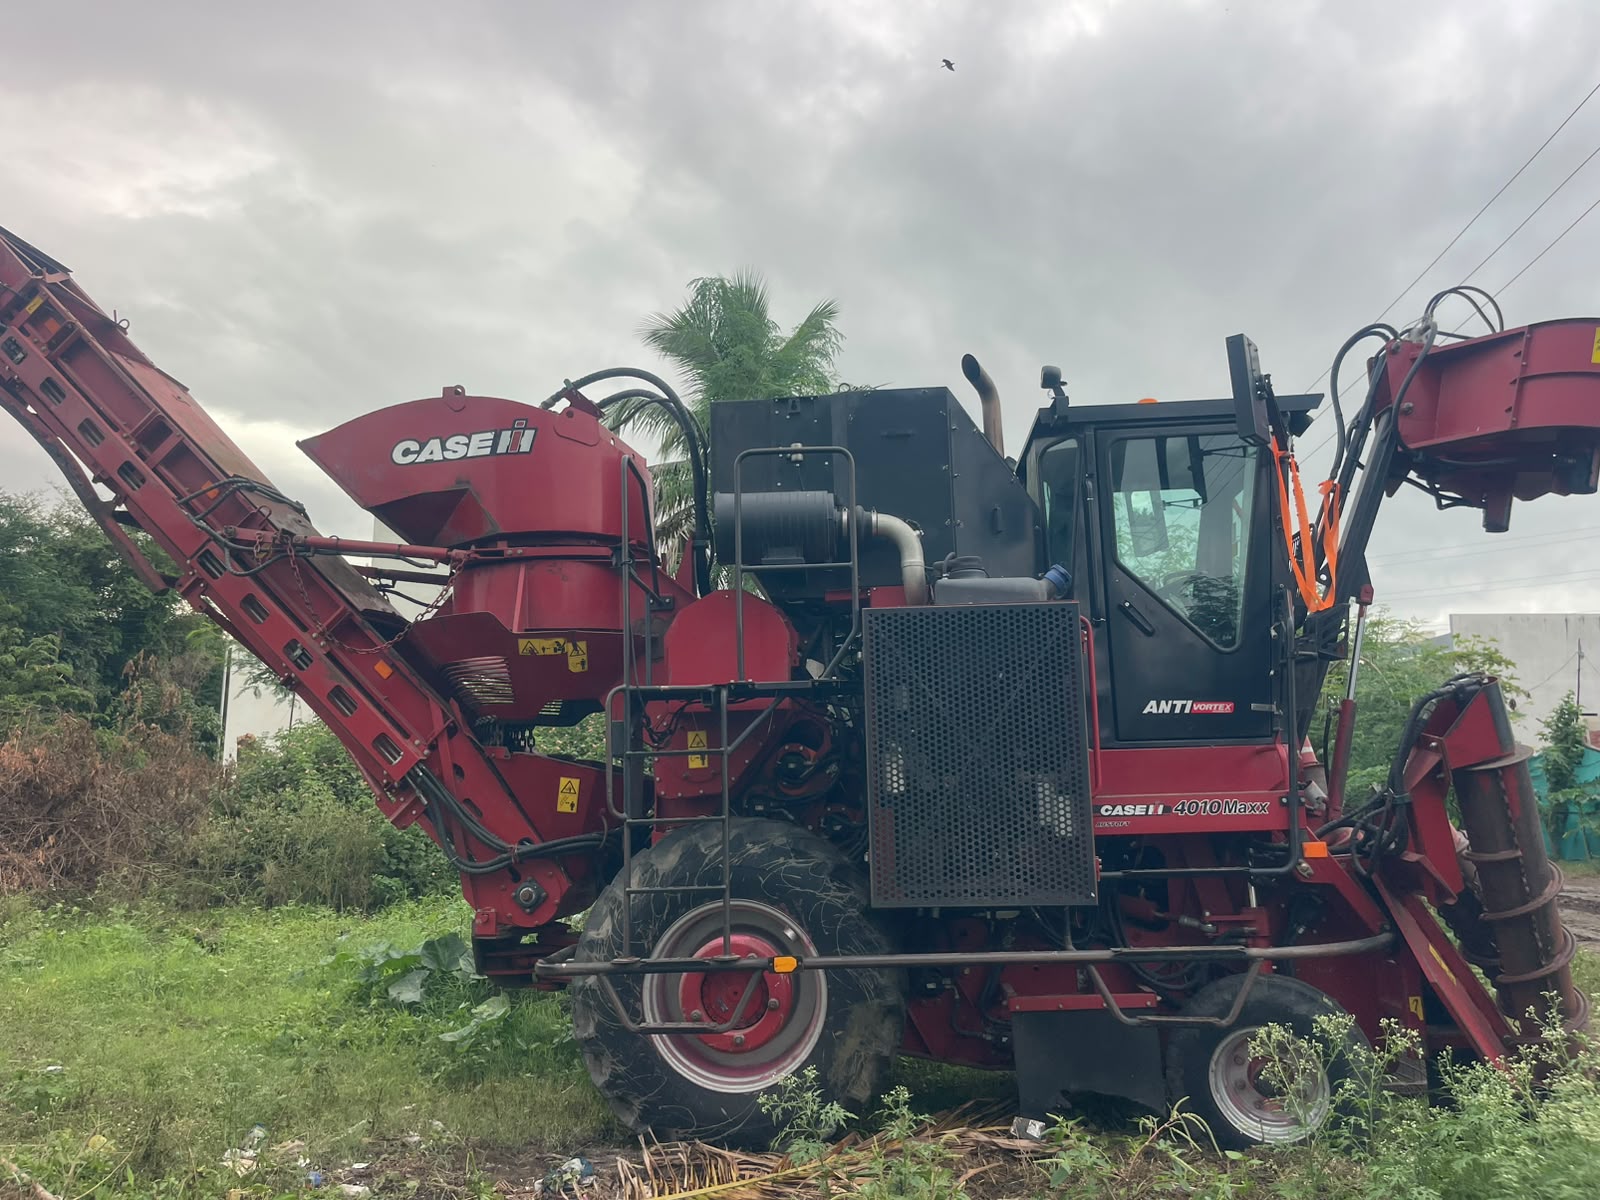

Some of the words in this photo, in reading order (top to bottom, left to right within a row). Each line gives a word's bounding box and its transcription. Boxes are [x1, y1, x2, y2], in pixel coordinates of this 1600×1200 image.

[391, 431, 495, 466] CASE
[1142, 699, 1193, 714] ANTI
[1193, 702, 1233, 712] VORTEX
[1100, 804, 1147, 816] CASE
[1173, 799, 1222, 816] 4010
[1223, 799, 1271, 815] Maxx
